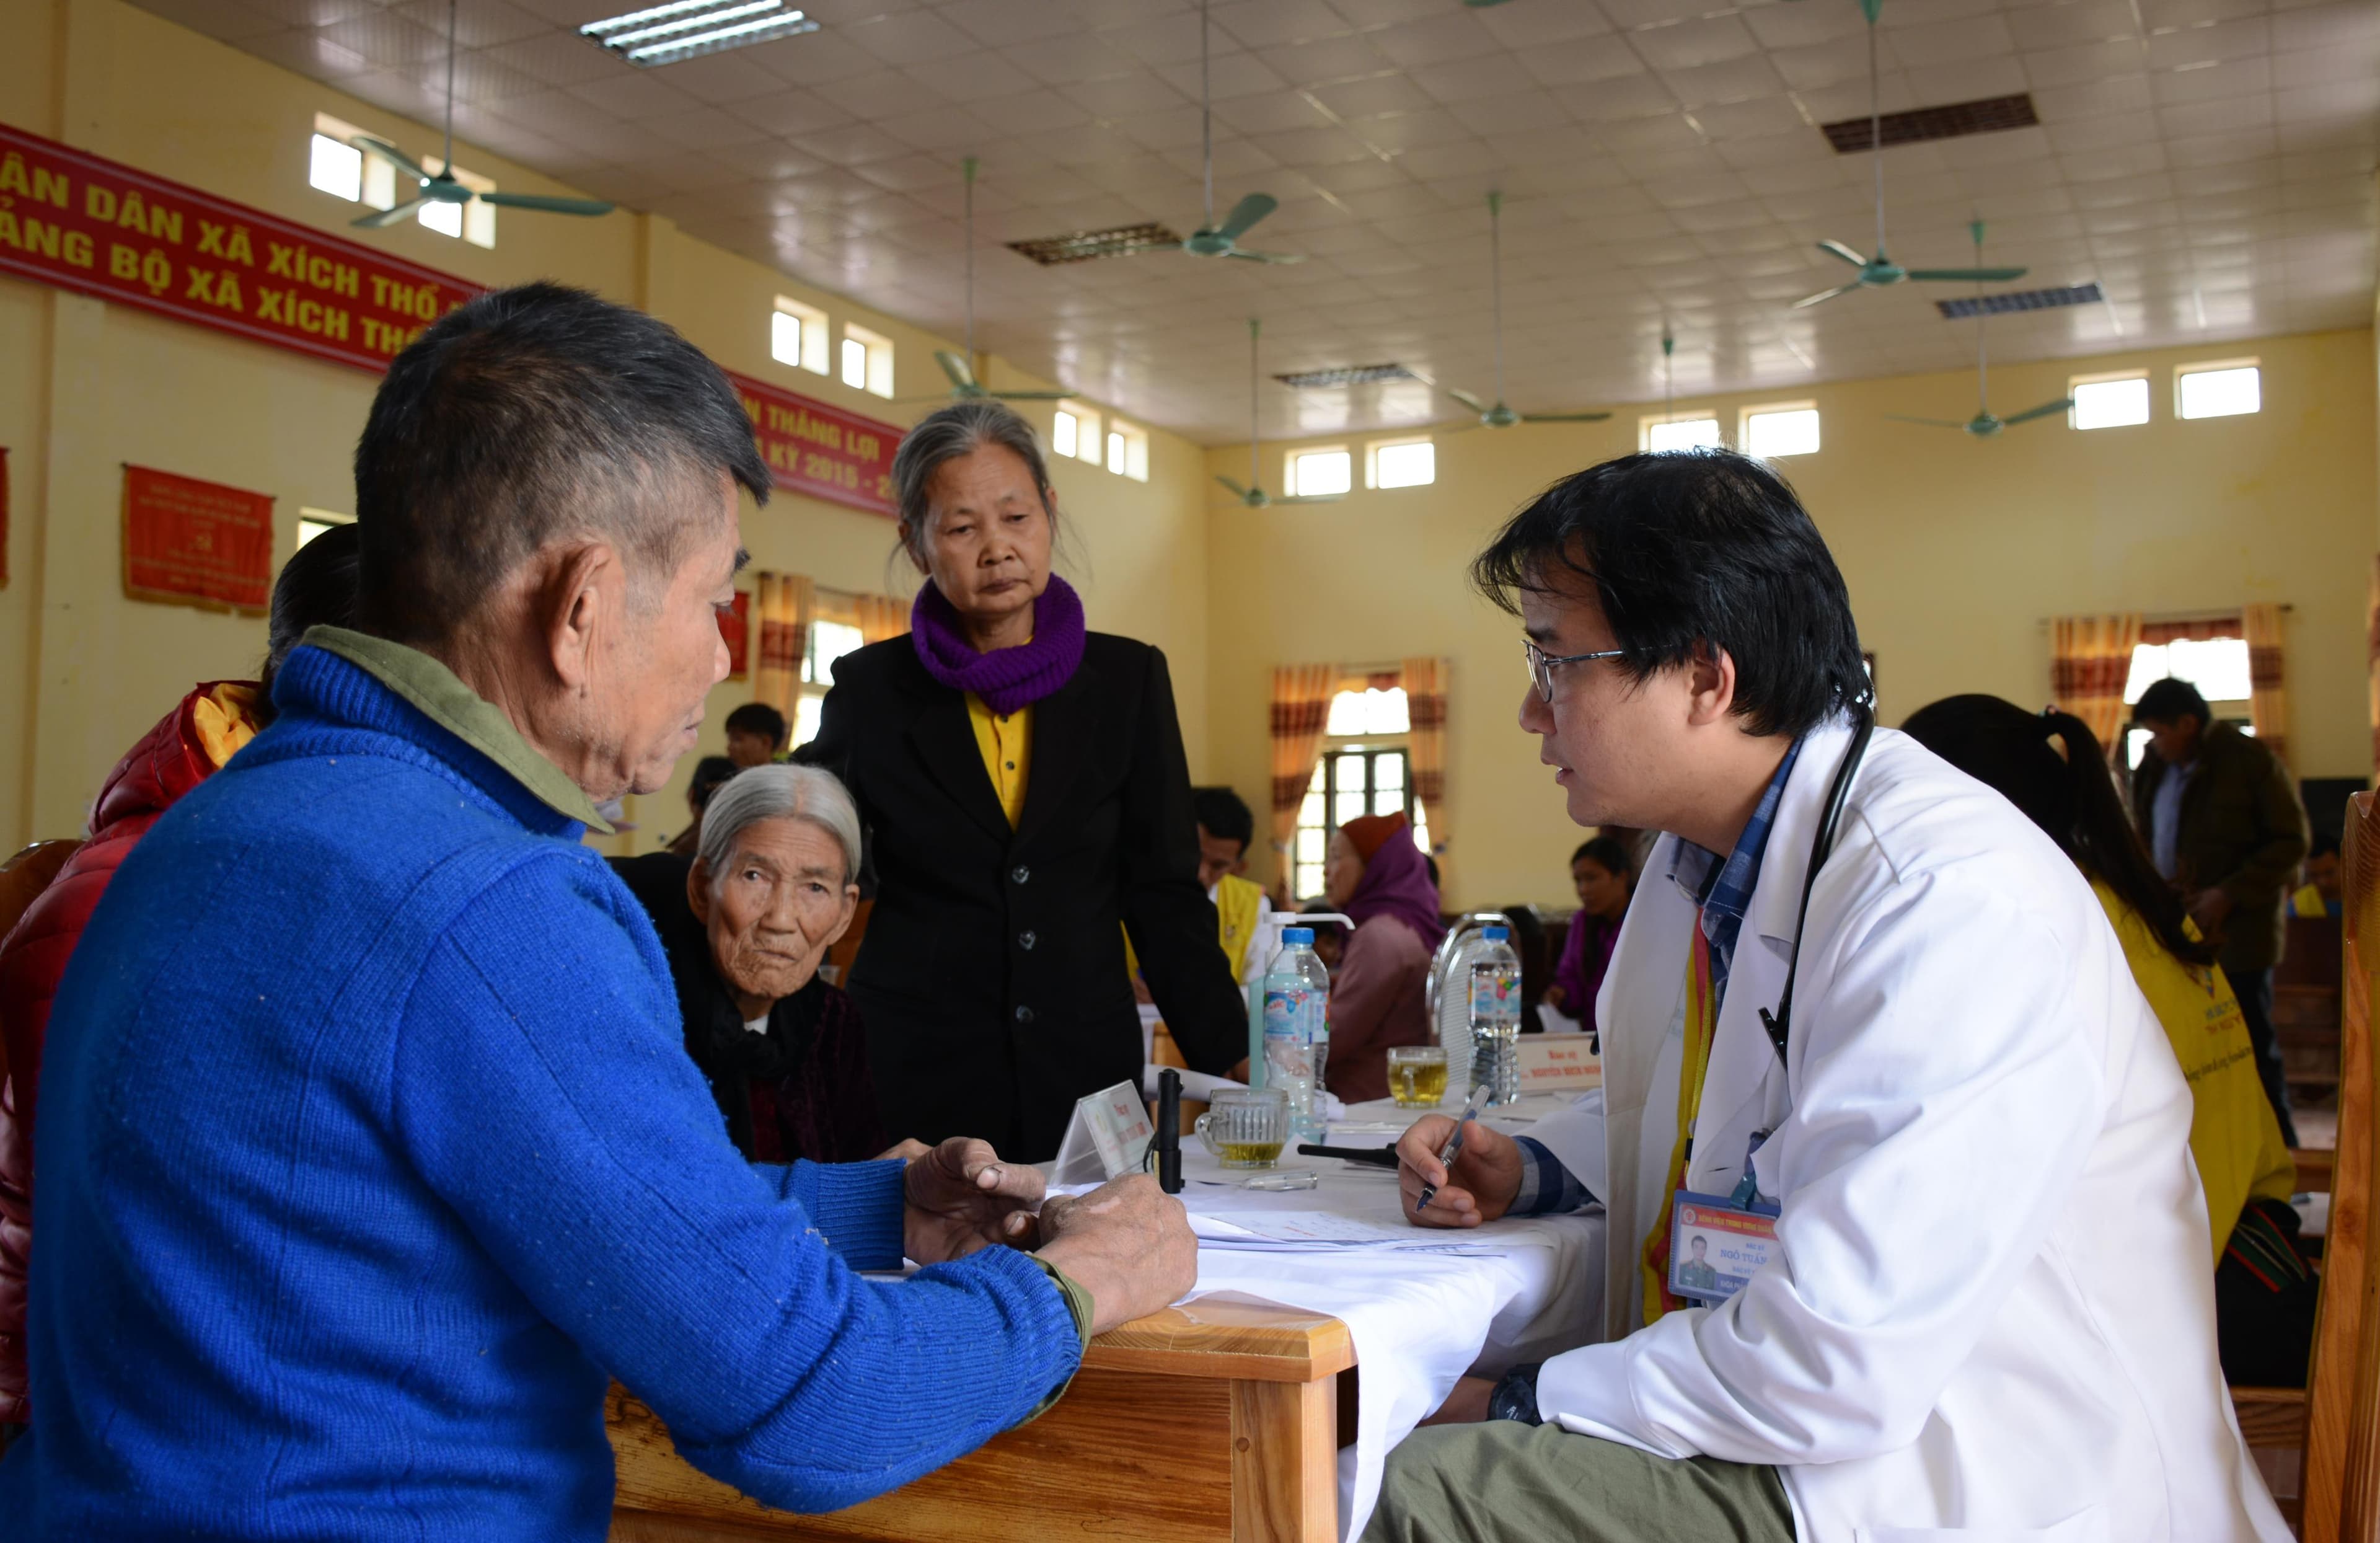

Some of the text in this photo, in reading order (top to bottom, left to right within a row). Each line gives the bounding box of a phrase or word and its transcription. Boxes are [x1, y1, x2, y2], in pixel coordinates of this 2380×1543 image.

[87, 186, 183, 244] DÂN
[198, 220, 255, 266] XÃ
[268, 243, 360, 298] XÍCH
[111, 244, 171, 295] BỘ
[187, 267, 243, 311] XÃ
[257, 286, 350, 341] XÍCH
[1721, 1249, 1740, 1260] NGÔ
